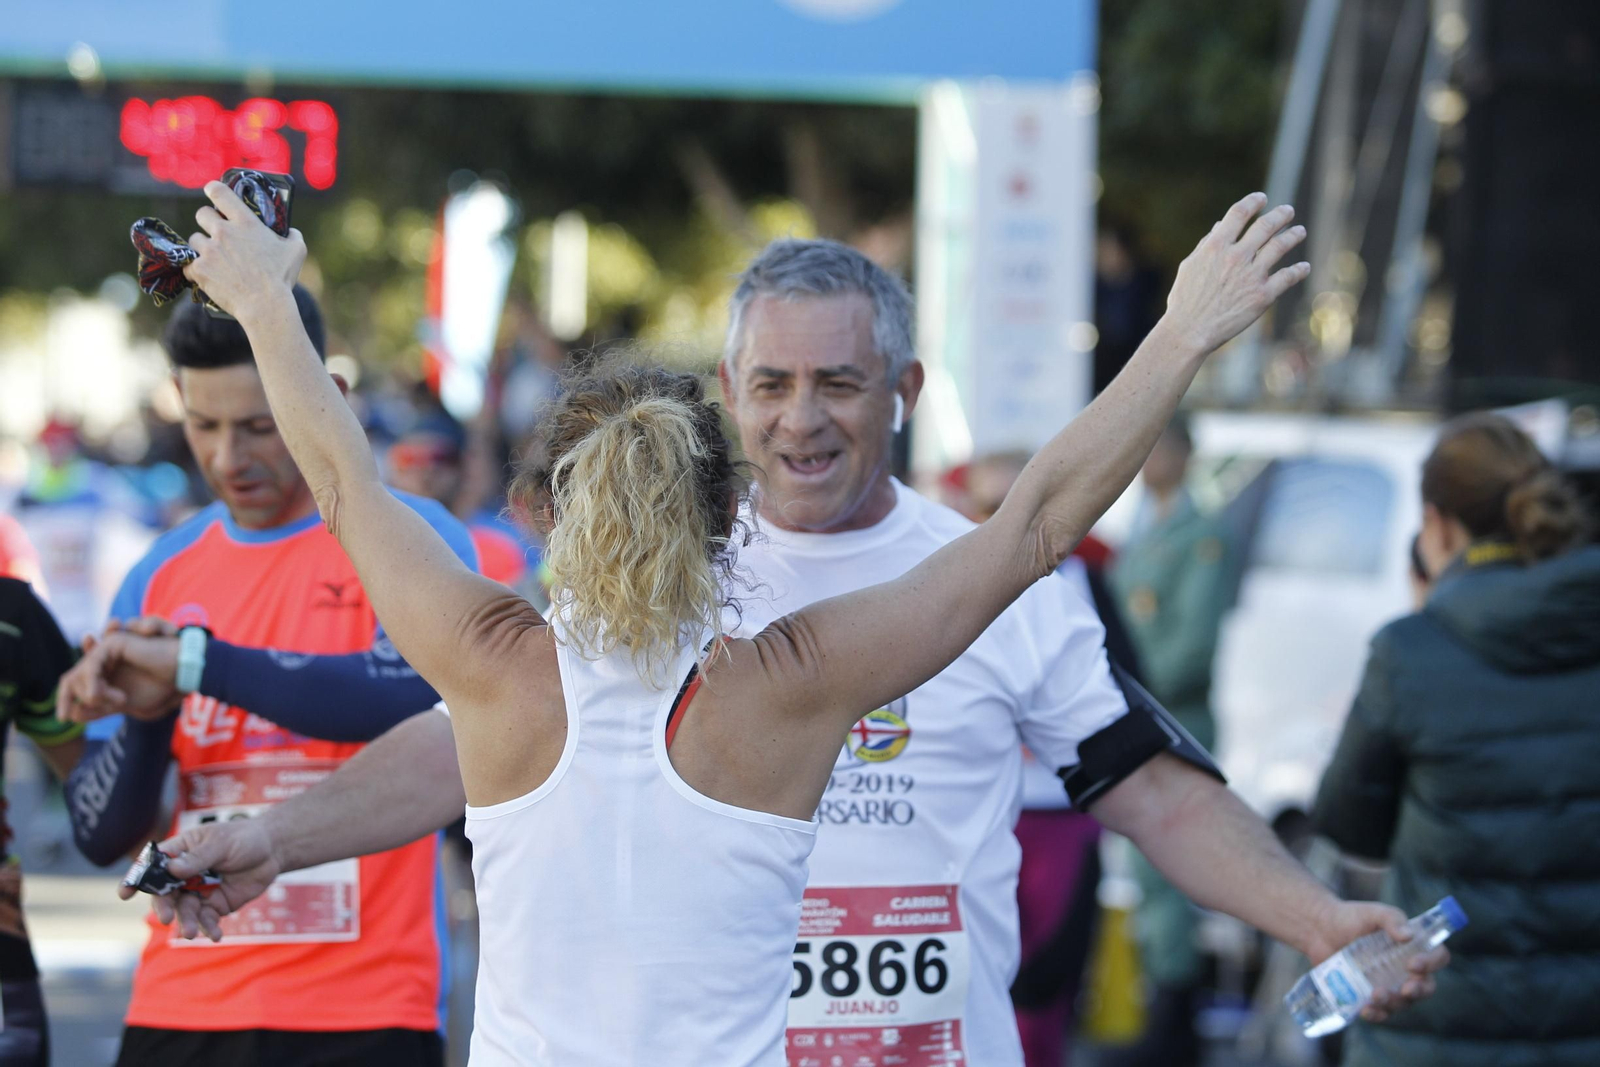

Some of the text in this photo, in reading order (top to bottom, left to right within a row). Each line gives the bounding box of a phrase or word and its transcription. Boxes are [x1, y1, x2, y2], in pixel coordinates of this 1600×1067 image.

[890, 896, 949, 909] CARRERA
[872, 912, 951, 927] SALUDABLE
[790, 938, 948, 998] 5866
[825, 1000, 899, 1015] JUANJO
